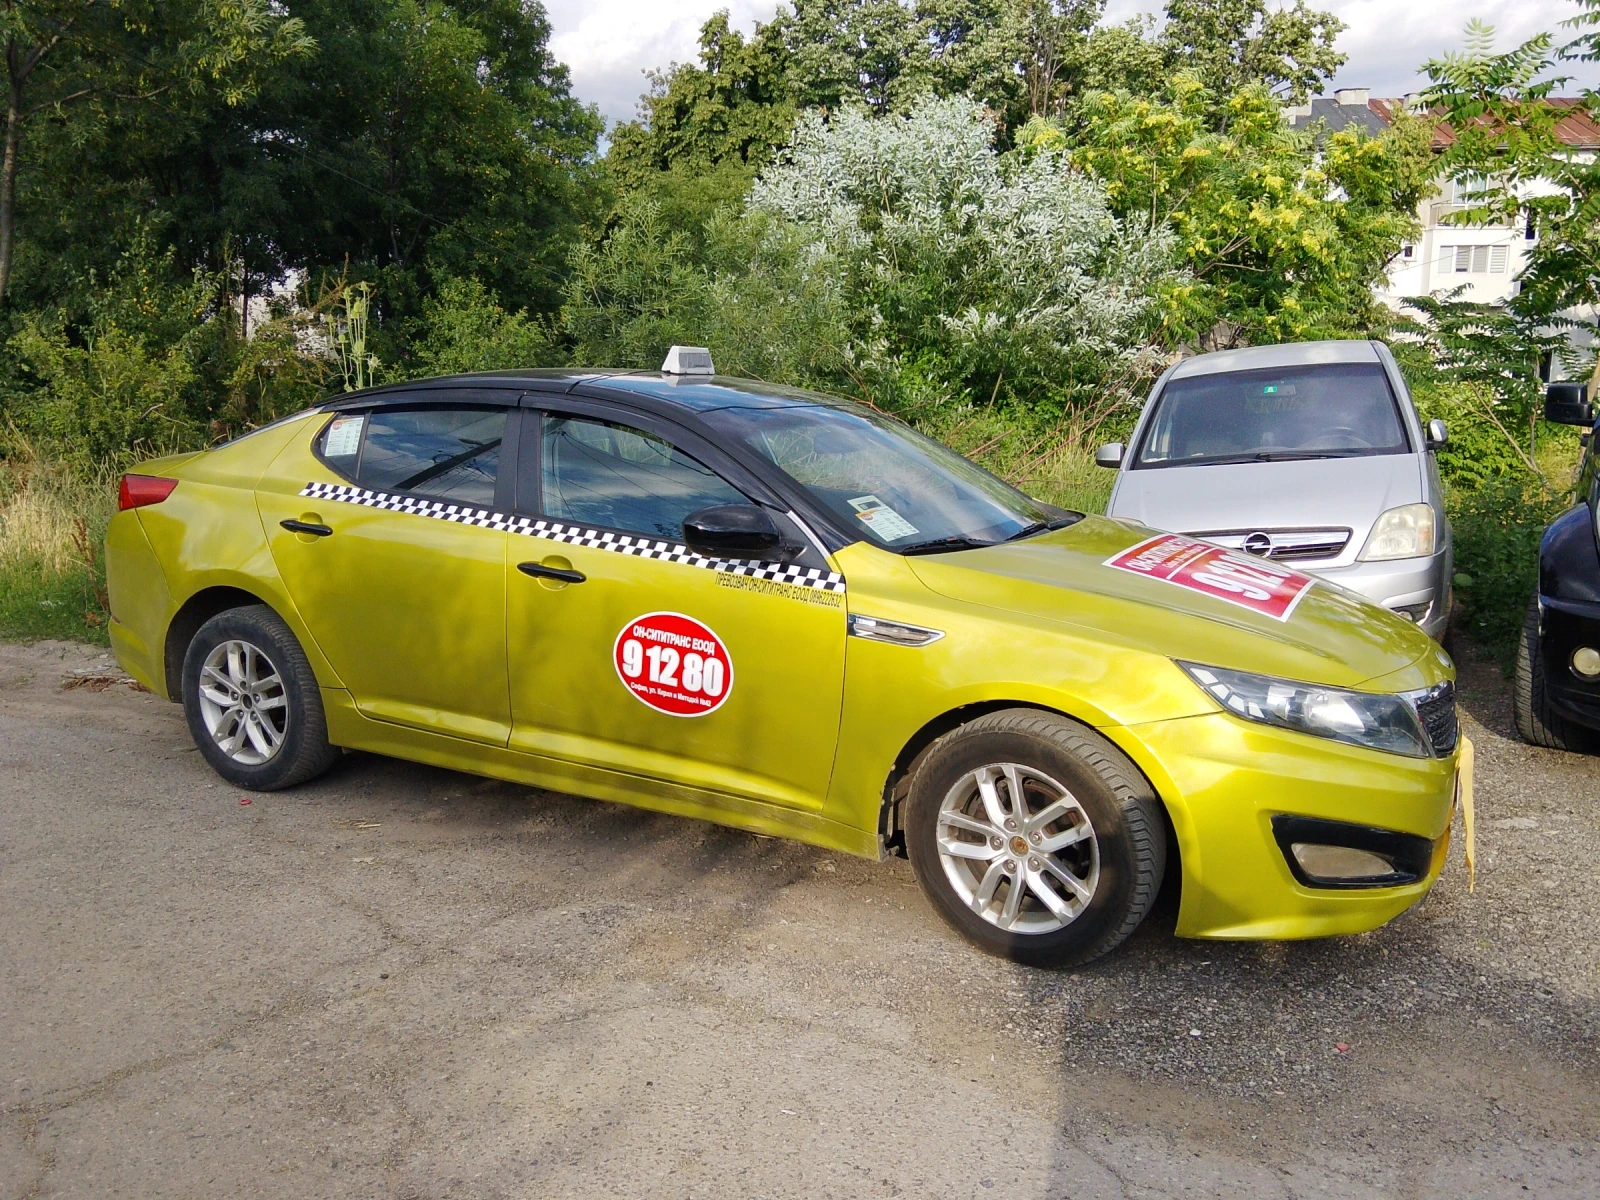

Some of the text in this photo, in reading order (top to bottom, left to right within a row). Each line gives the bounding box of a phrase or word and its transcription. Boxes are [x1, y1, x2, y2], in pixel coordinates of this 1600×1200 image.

[1190, 572, 1271, 601] 9
[1204, 560, 1285, 588] 12
[791, 587, 810, 604] ЕООД
[633, 625, 715, 656] ОН-СИТИТРАНС ЕООД
[622, 639, 724, 697] 9 12 80
